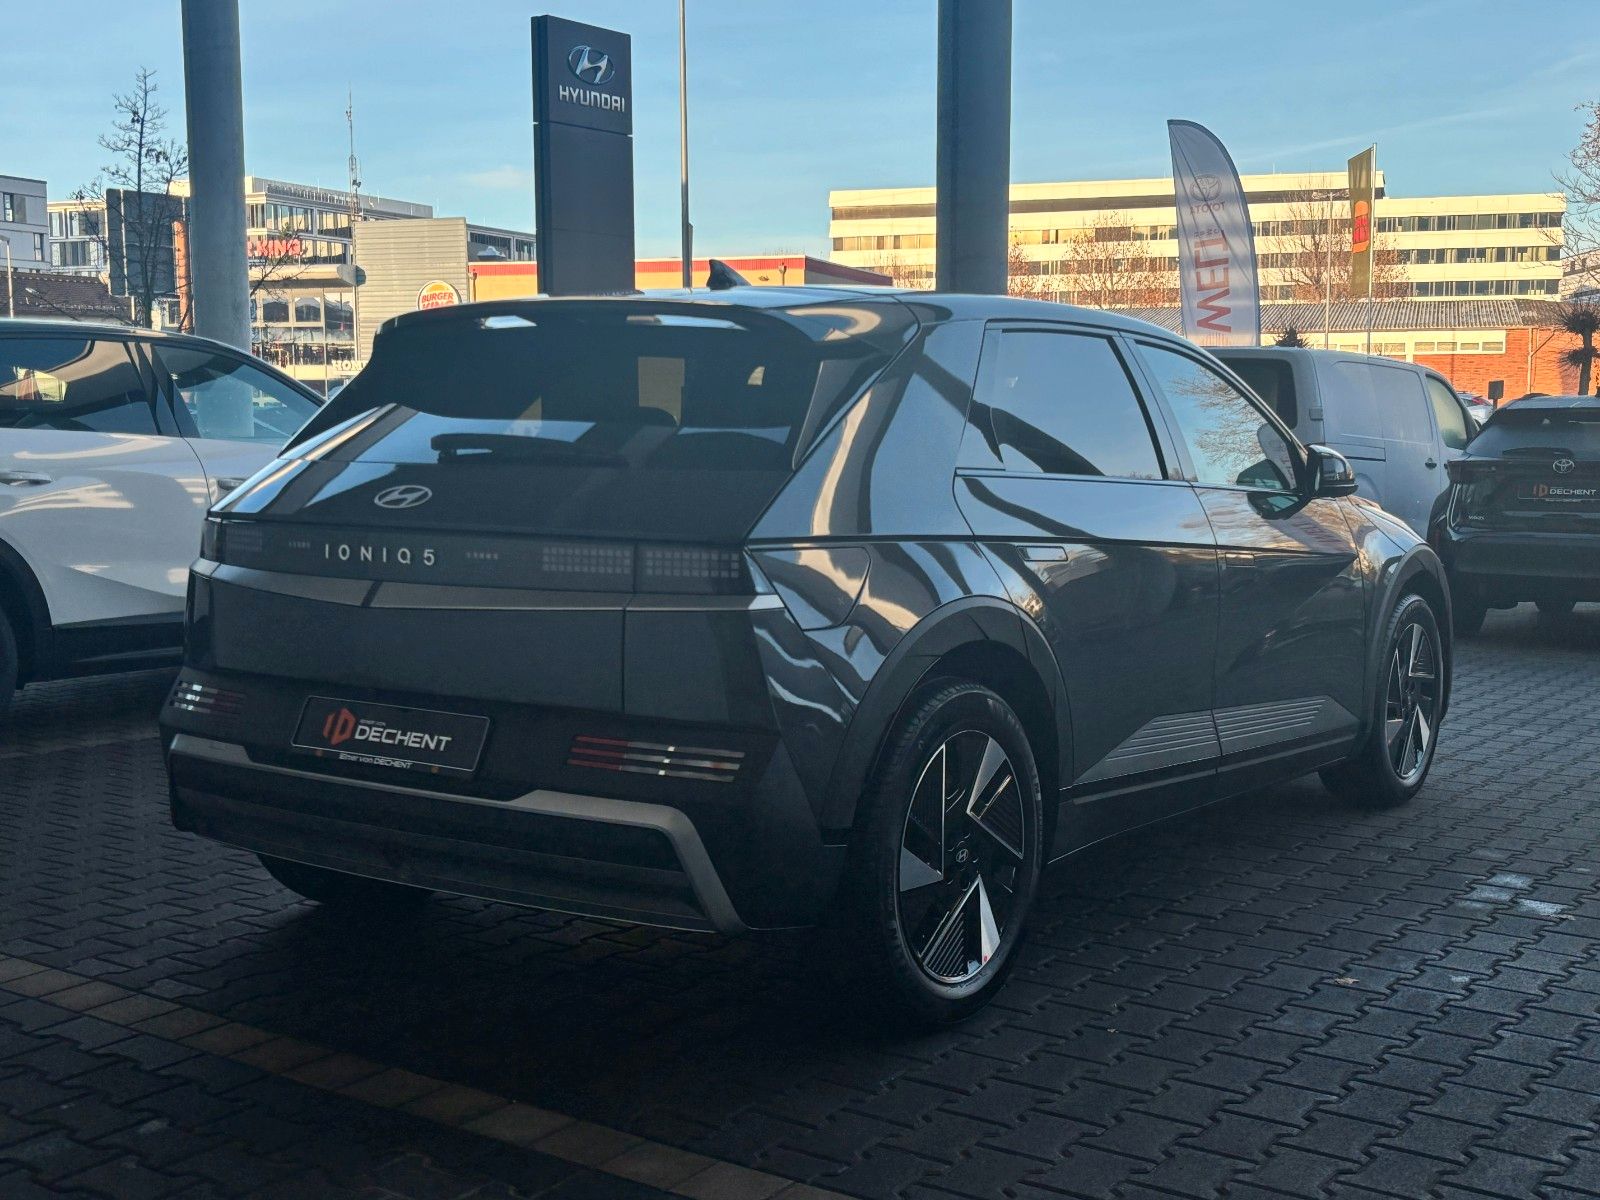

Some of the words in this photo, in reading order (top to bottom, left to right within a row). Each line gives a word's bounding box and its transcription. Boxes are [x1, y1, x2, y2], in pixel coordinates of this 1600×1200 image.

[559, 84, 625, 112] HYUNDAI
[421, 292, 453, 303] BURGER
[1549, 488, 1597, 496] DECHENT
[325, 543, 411, 564] IONIQ
[423, 549, 435, 566] 5
[354, 725, 452, 751] DECHENT
[373, 757, 414, 769] DECHENT
